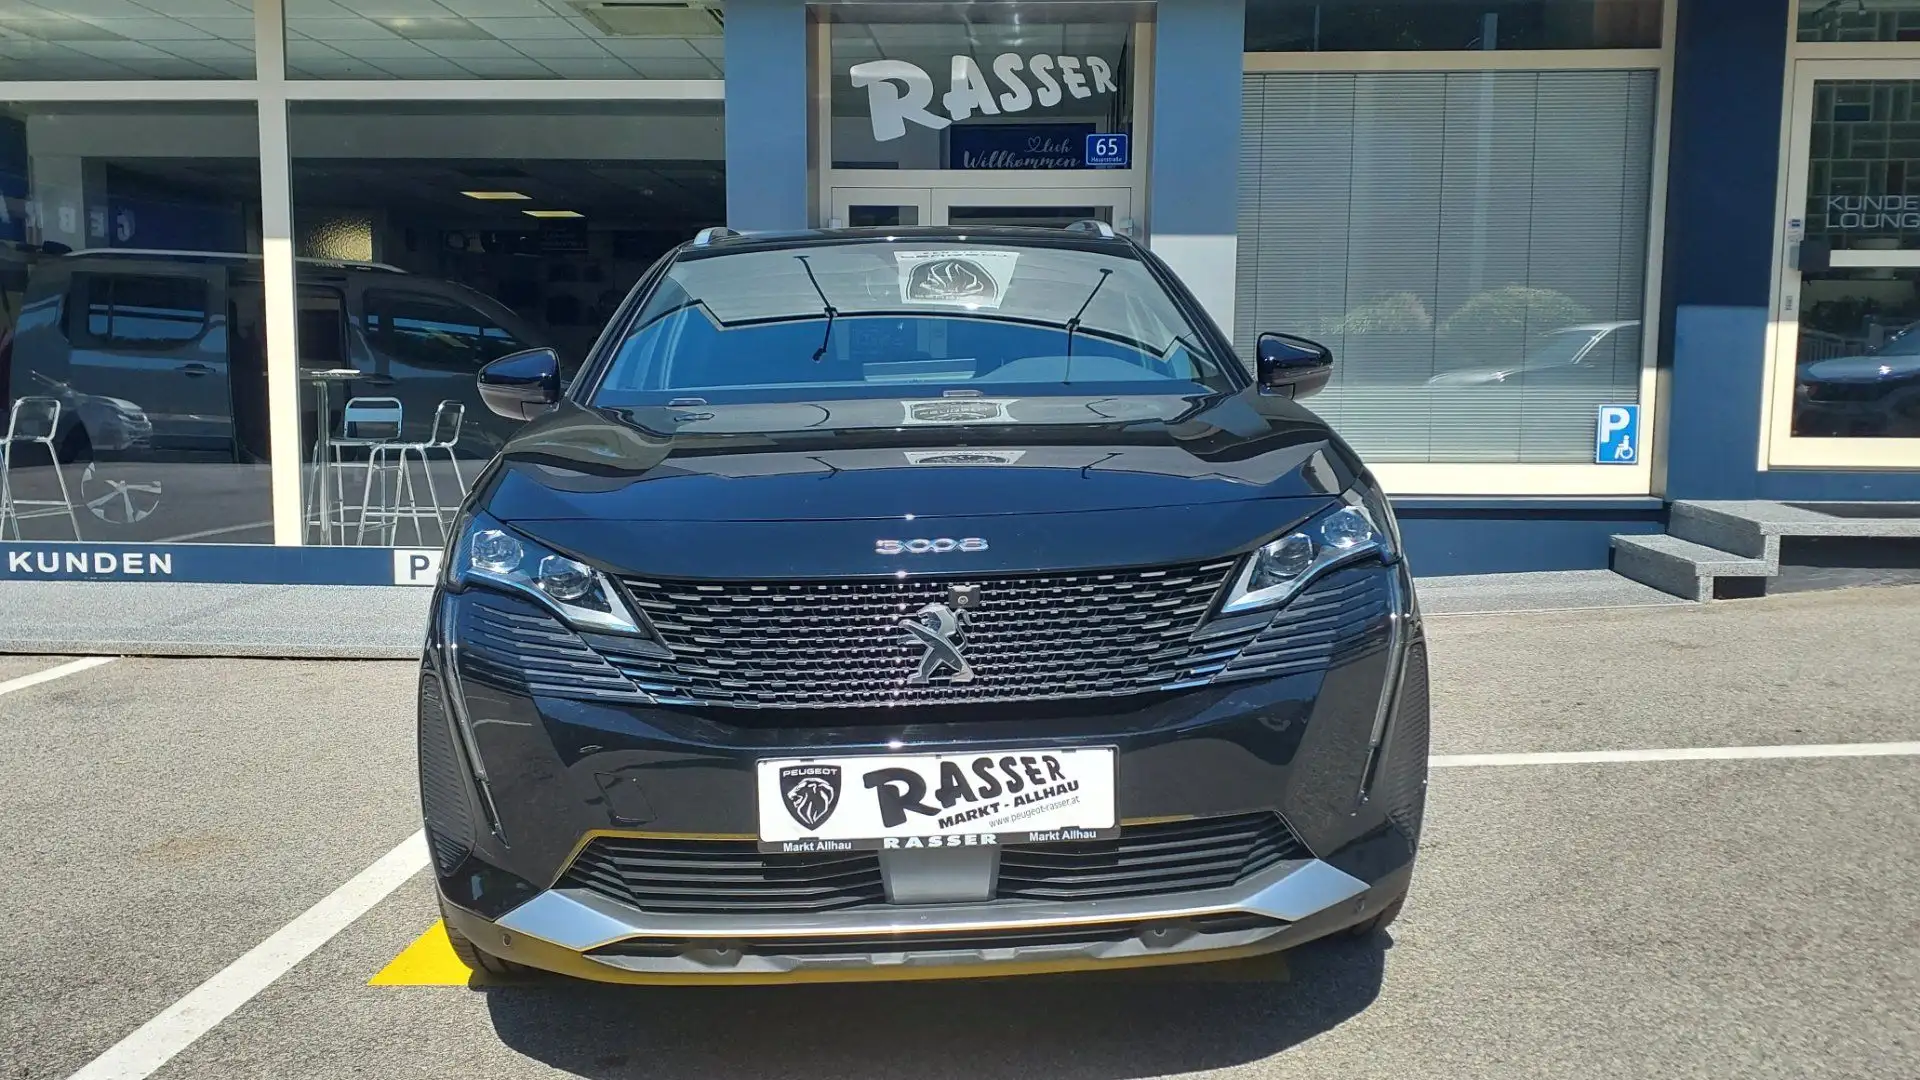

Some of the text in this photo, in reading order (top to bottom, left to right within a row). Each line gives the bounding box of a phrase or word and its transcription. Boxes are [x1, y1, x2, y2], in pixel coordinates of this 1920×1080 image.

[850, 53, 1117, 141] RASSER
[1096, 138, 1118, 155] 65
[963, 150, 1080, 168] Willkommen
[1826, 212, 1920, 228] LOUNG
[1600, 407, 1630, 443] P
[875, 538, 988, 555] 5008
[8, 551, 172, 574] KUNDEN
[410, 555, 430, 580] P
[782, 768, 838, 777] PEUGEOT
[863, 755, 1066, 828] RASSER
[938, 802, 1000, 829] MARKT
[1013, 780, 1079, 807] ALLHAU
[988, 795, 1080, 828] www.peugeot-rasser.at
[883, 833, 998, 848] RASSER
[1029, 829, 1096, 841] Markt Allhau
[783, 840, 852, 852] Markt Allhau
